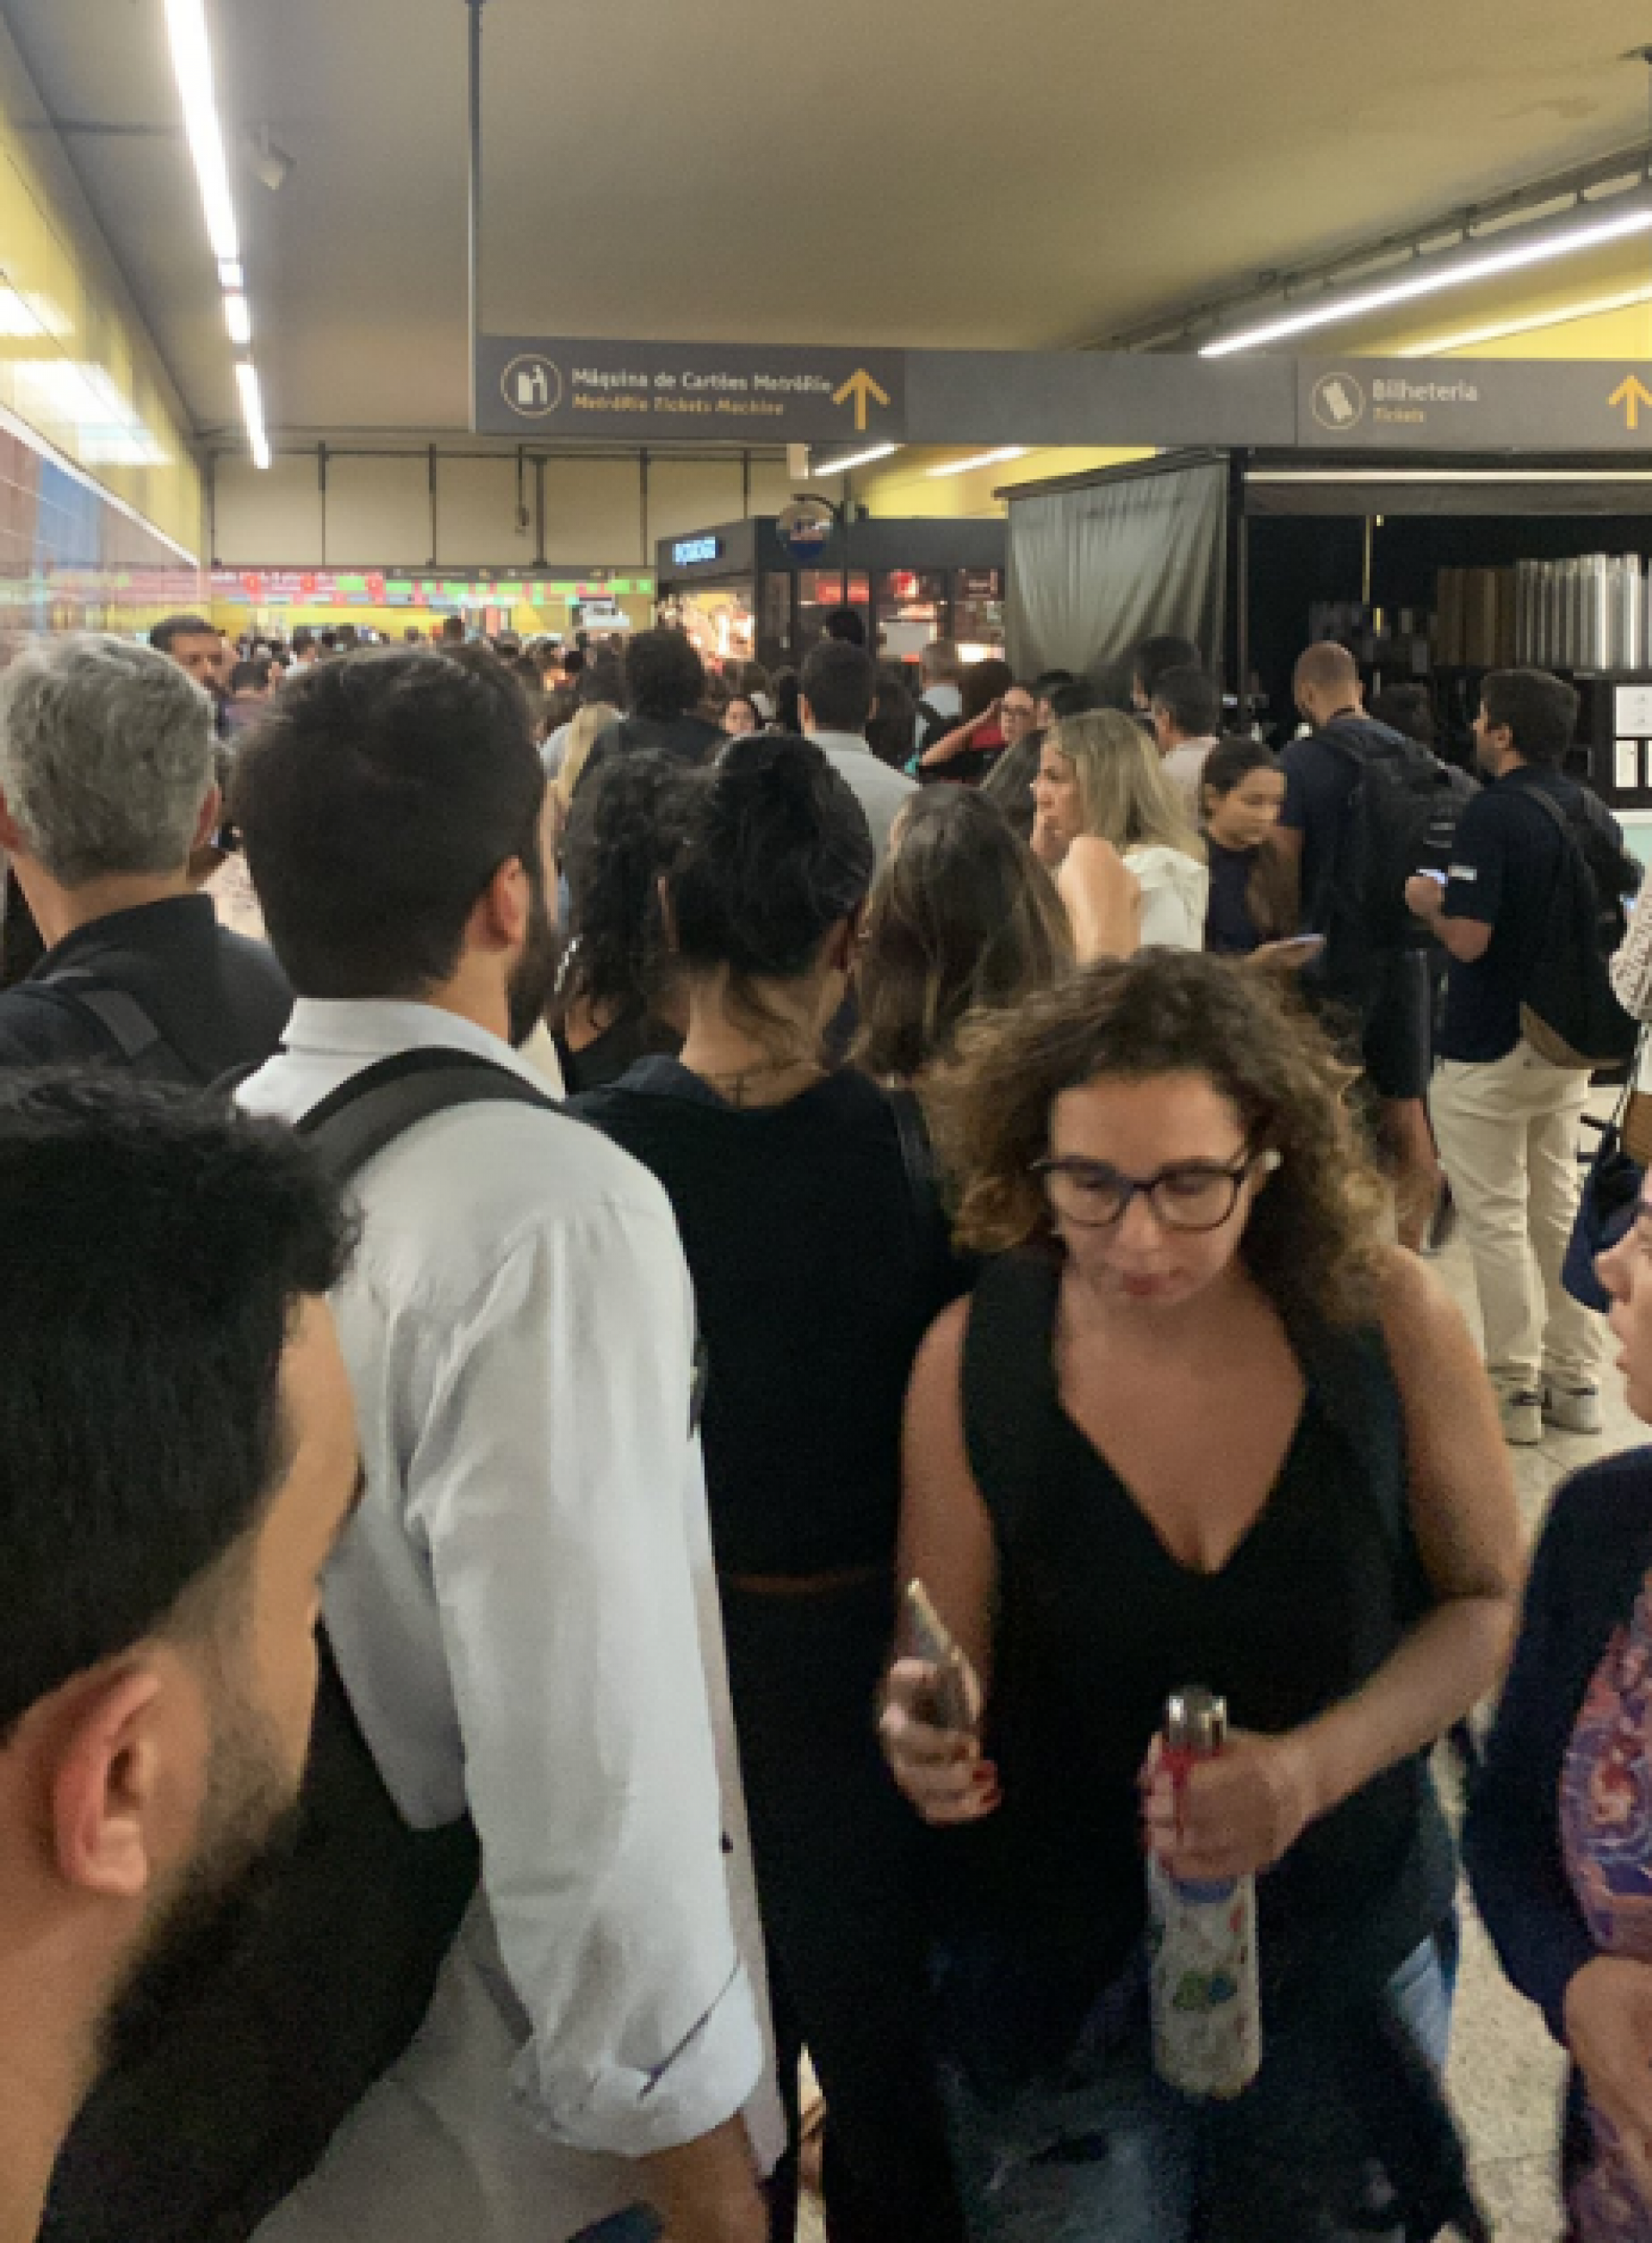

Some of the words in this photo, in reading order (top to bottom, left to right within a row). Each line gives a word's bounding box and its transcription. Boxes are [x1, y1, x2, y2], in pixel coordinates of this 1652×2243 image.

[572, 367, 648, 390] Máquina
[654, 370, 676, 389] de
[1372, 379, 1478, 401] Bilheteria
